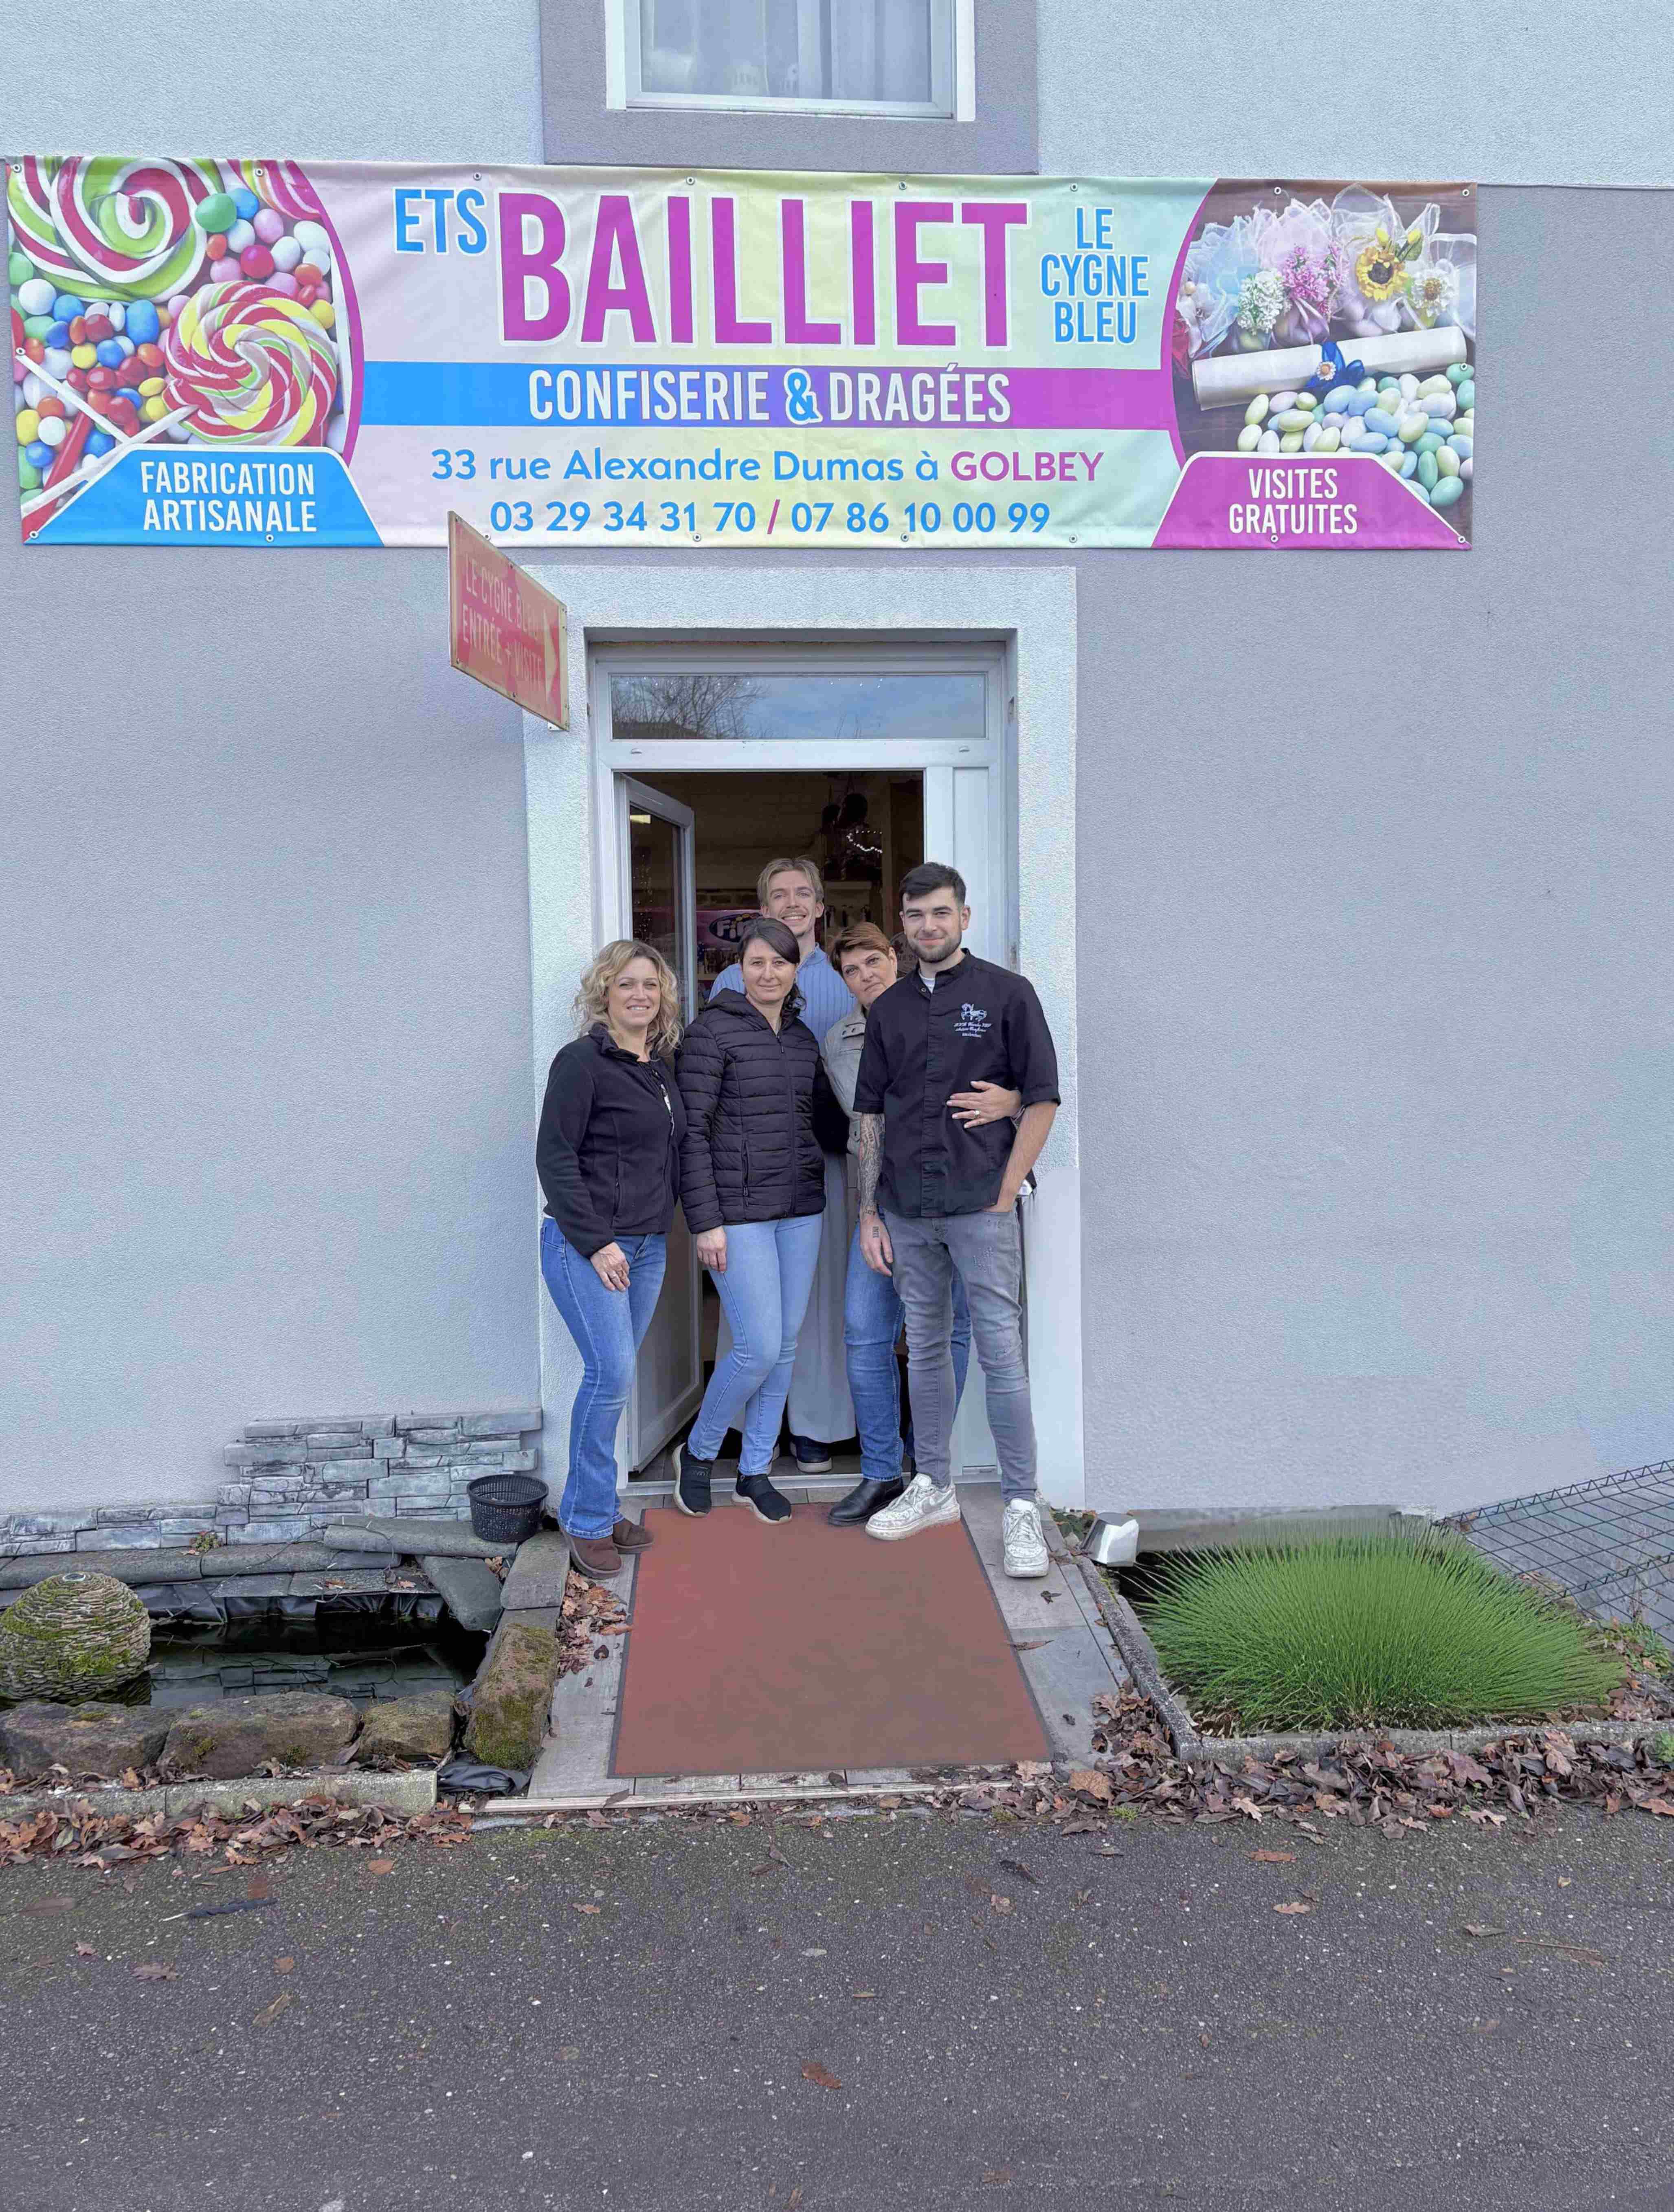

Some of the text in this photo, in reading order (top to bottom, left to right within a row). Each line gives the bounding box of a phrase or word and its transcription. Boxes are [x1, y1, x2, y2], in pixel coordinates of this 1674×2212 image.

[1076, 208, 1113, 250] LE
[395, 189, 1027, 346] ETS BAILLIET
[1041, 254, 1148, 296] CYGNE
[1055, 301, 1136, 343] BLEU
[529, 363, 1011, 422] CONFISERIE & DRAGÉES
[141, 461, 314, 495] FABRICATION
[432, 447, 1103, 481] 33 rue Alexandre Dumas à GOLBEY
[1249, 468, 1338, 499] VISITES
[143, 499, 316, 532] ARTISANALE
[490, 499, 1050, 534] 03 29 34 31 70 / 07 86 10 00 99
[1229, 504, 1358, 534] GRATUITES
[466, 553, 477, 598] LE
[481, 566, 513, 623] CYGNE
[463, 602, 502, 665] ENTRÉE
